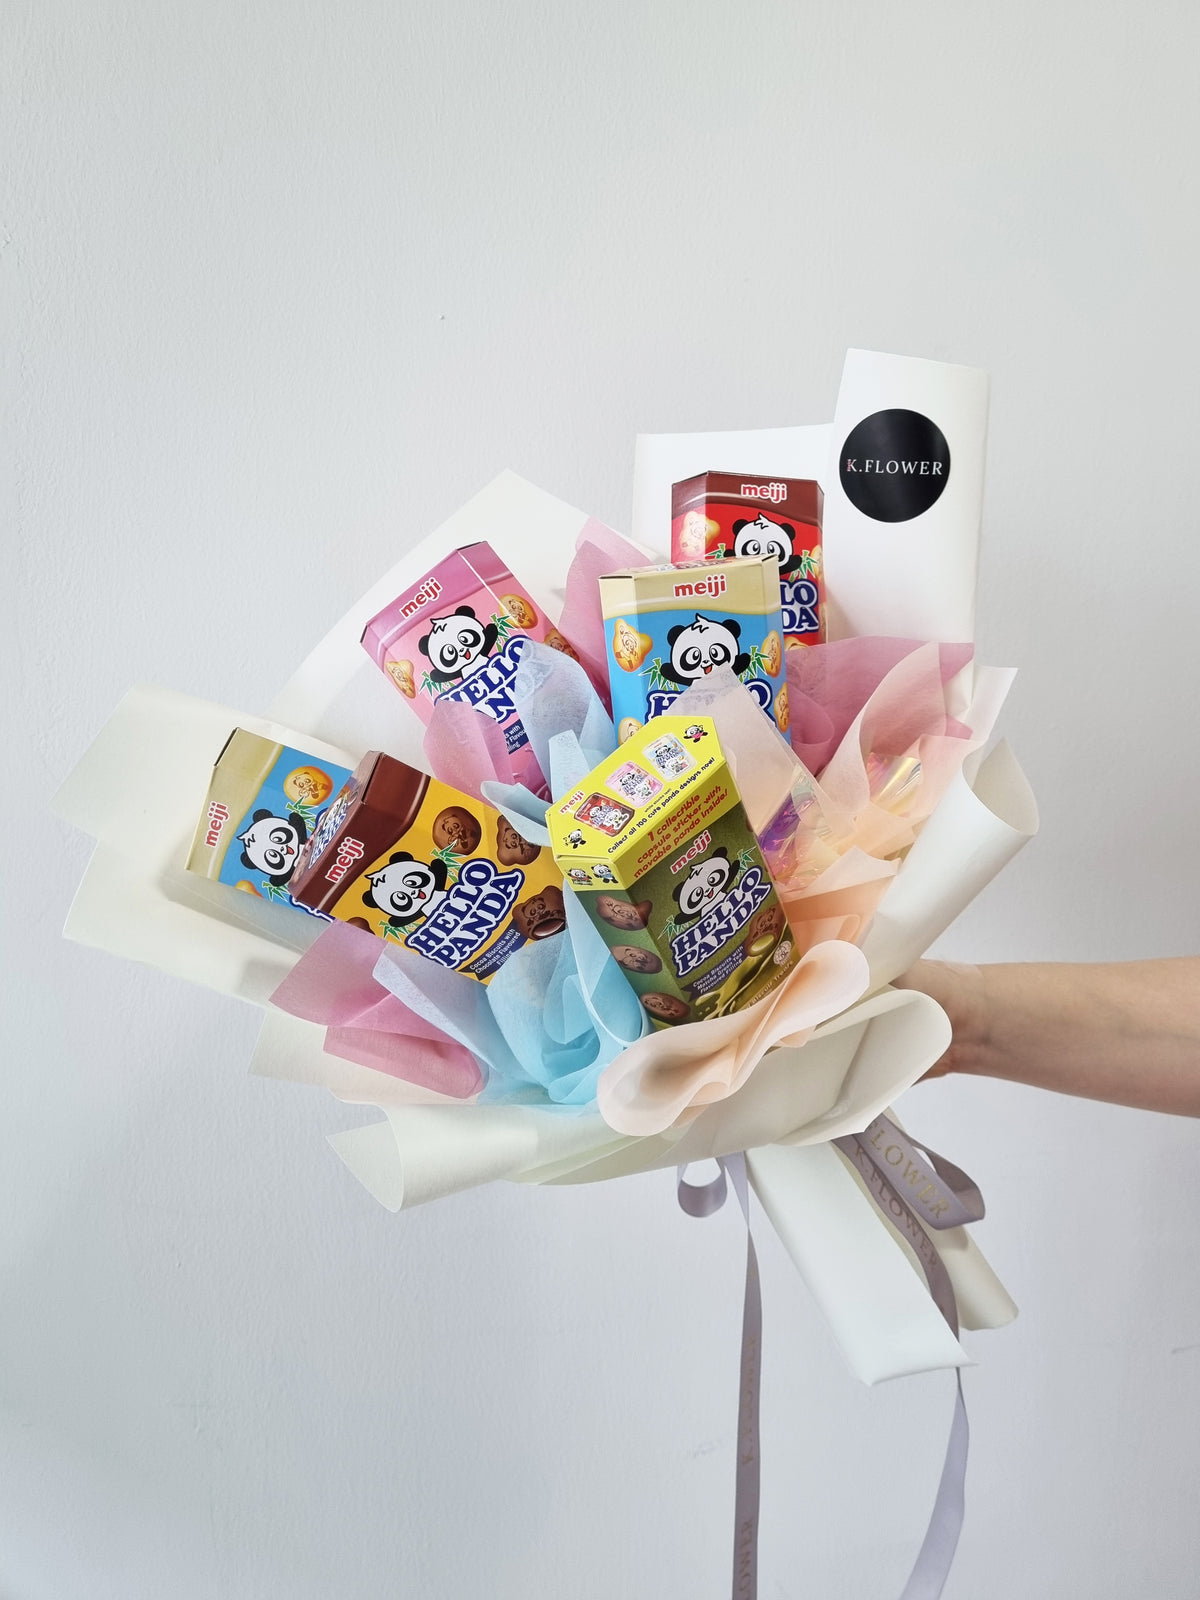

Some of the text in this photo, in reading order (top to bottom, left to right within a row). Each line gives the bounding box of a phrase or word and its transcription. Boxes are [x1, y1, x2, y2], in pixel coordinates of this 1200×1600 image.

[846, 458, 943, 475] K.FLOWER
[741, 482, 788, 503] meiji
[399, 578, 442, 619] meiji
[674, 573, 727, 598] meiji
[204, 801, 230, 848] meiji
[559, 790, 585, 815] meiji
[608, 834, 628, 854] Collect
[628, 827, 637, 836] all
[636, 818, 648, 828] 100
[648, 806, 661, 818] cute
[661, 790, 680, 807] panda
[679, 770, 701, 790] designs
[637, 785, 721, 864] capsule sticker with
[648, 794, 700, 841] 1 collectible
[325, 836, 365, 883] meiji
[634, 844, 672, 878] movable
[673, 818, 701, 846] panda
[670, 829, 712, 874] meiji
[408, 860, 495, 956] HELLO
[432, 871, 522, 968] PANDA
[673, 867, 761, 957] HELLO
[678, 884, 772, 975] PANDA
[470, 928, 516, 970] Cocoa Biscuits with
[475, 931, 521, 973] Chocolate Flavoured
[869, 1121, 950, 1219] LOWER
[855, 1142, 938, 1272] K.FLOWER
